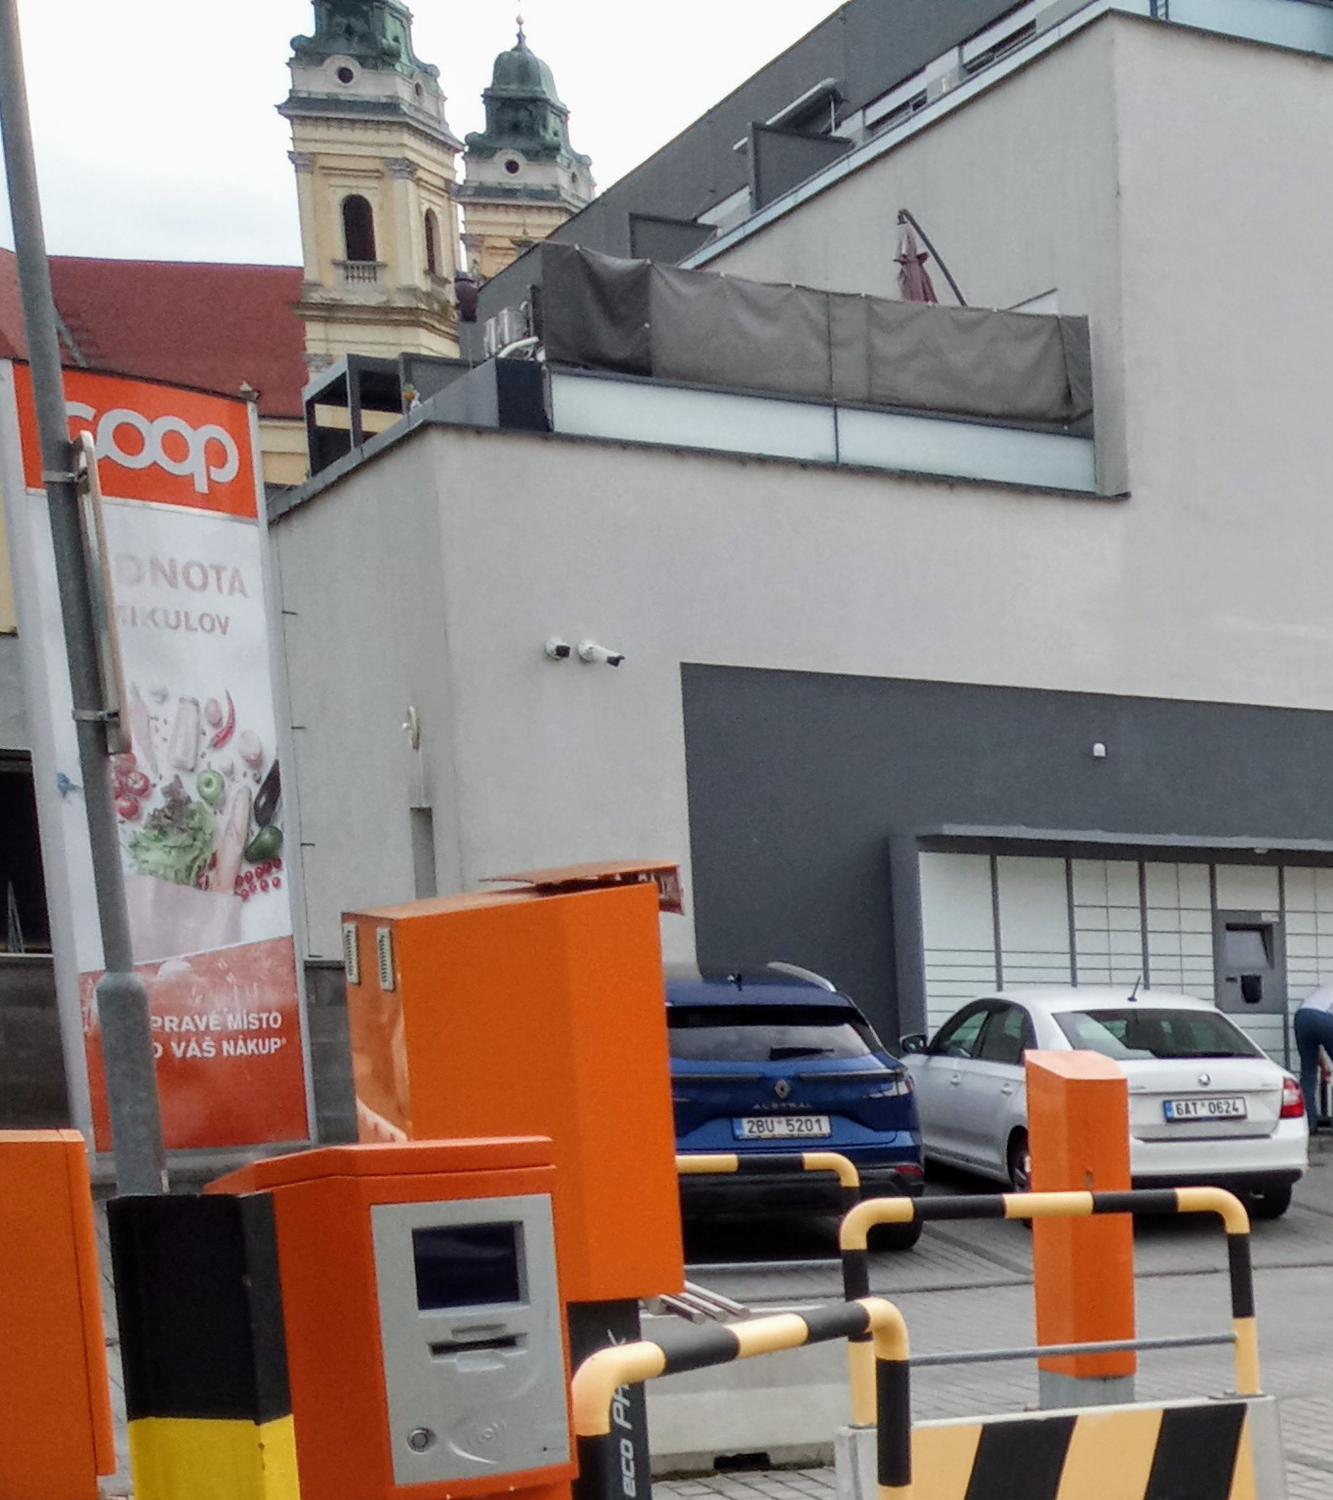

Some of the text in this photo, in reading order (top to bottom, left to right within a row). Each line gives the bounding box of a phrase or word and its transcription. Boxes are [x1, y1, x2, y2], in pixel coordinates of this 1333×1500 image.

[114, 553, 249, 598] DNOTA
[152, 1008, 283, 1033] PRAVÉ MÍSTO
[170, 1036, 217, 1059] VÁŠ
[1175, 1101, 1240, 1116] 6AT 0624
[746, 1117, 824, 1135] 2BU 5201
